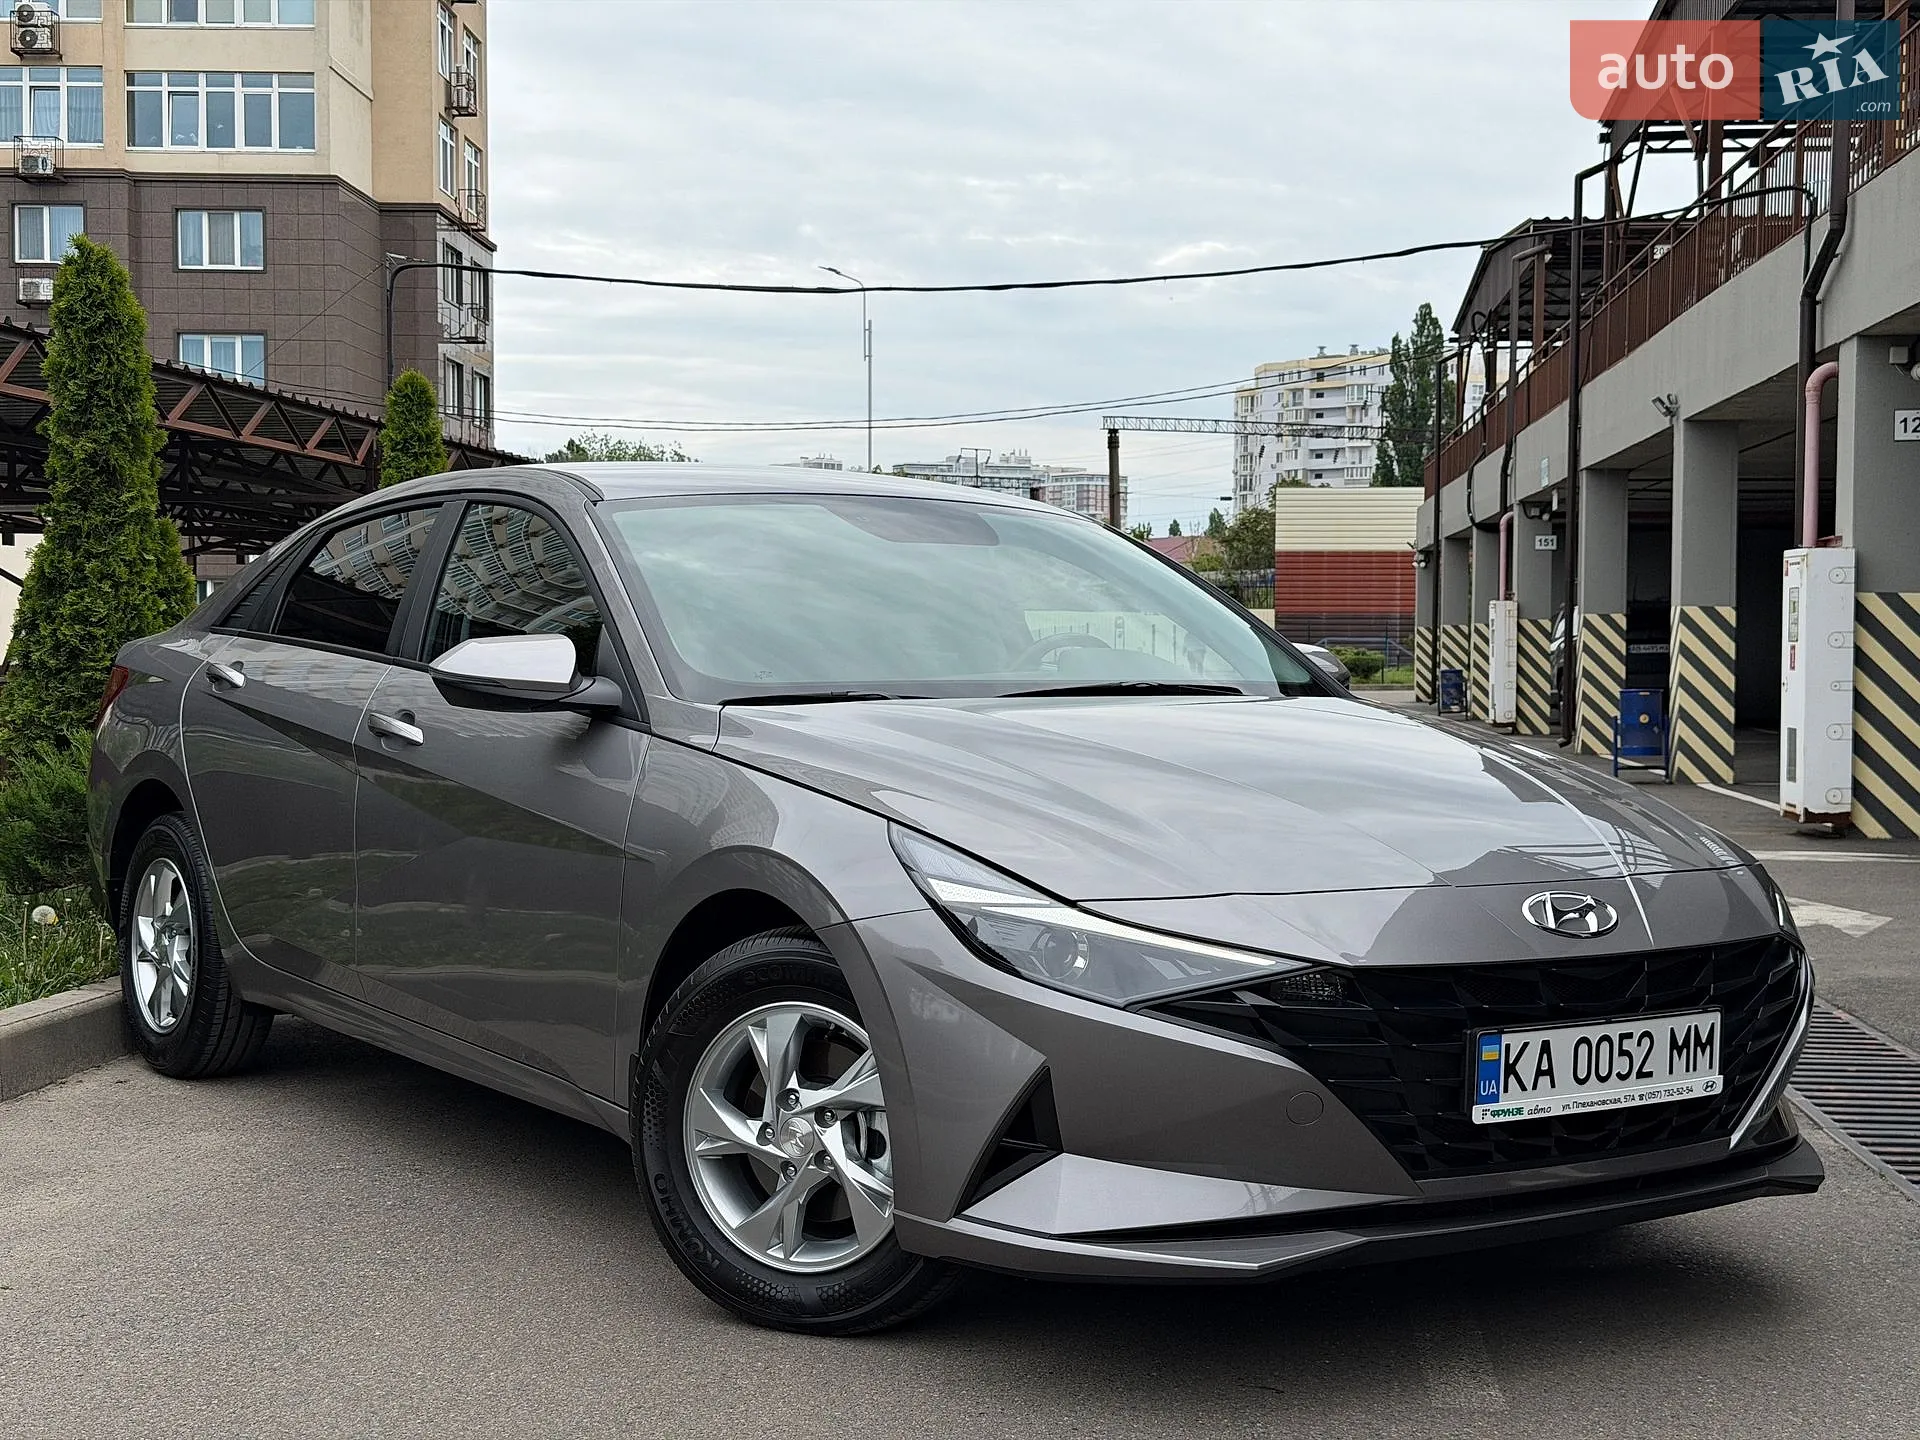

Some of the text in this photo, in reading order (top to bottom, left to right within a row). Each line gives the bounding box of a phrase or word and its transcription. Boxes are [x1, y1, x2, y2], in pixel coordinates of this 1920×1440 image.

[1654, 246, 1671, 256] 20
[1537, 538, 1555, 548] 151
[1502, 1021, 1716, 1094] KA 0052 MM
[1480, 1079, 1498, 1096] UA
[1490, 1106, 1525, 1118] ФРУНЗЕ
[1527, 1104, 1552, 1116] авто
[1645, 1089, 1663, 1102] (057)
[1663, 1085, 1694, 1098] 732-52-54
[654, 1173, 721, 1269] KUMHO
